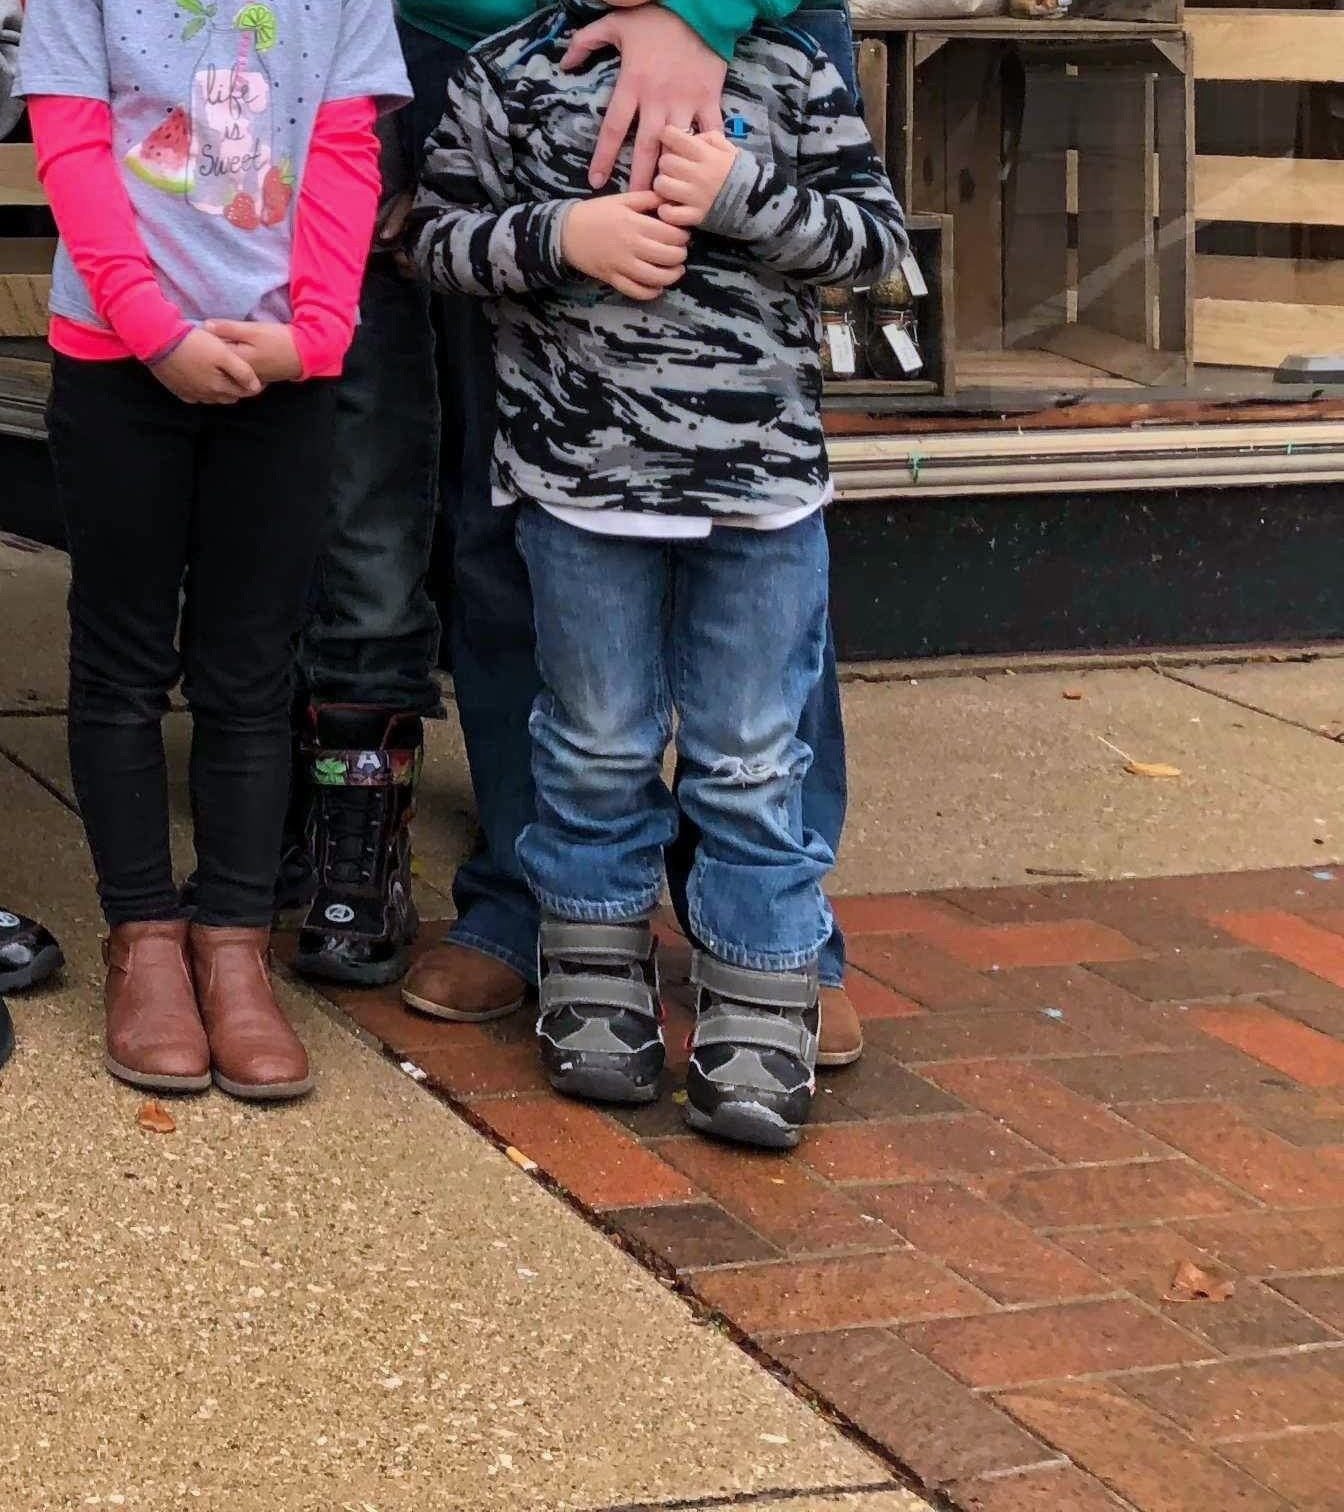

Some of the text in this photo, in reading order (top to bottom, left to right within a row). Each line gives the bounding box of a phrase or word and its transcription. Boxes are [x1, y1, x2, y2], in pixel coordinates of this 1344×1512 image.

[207, 62, 260, 119] life
[225, 123, 245, 141] is
[199, 138, 268, 176] Sweet
